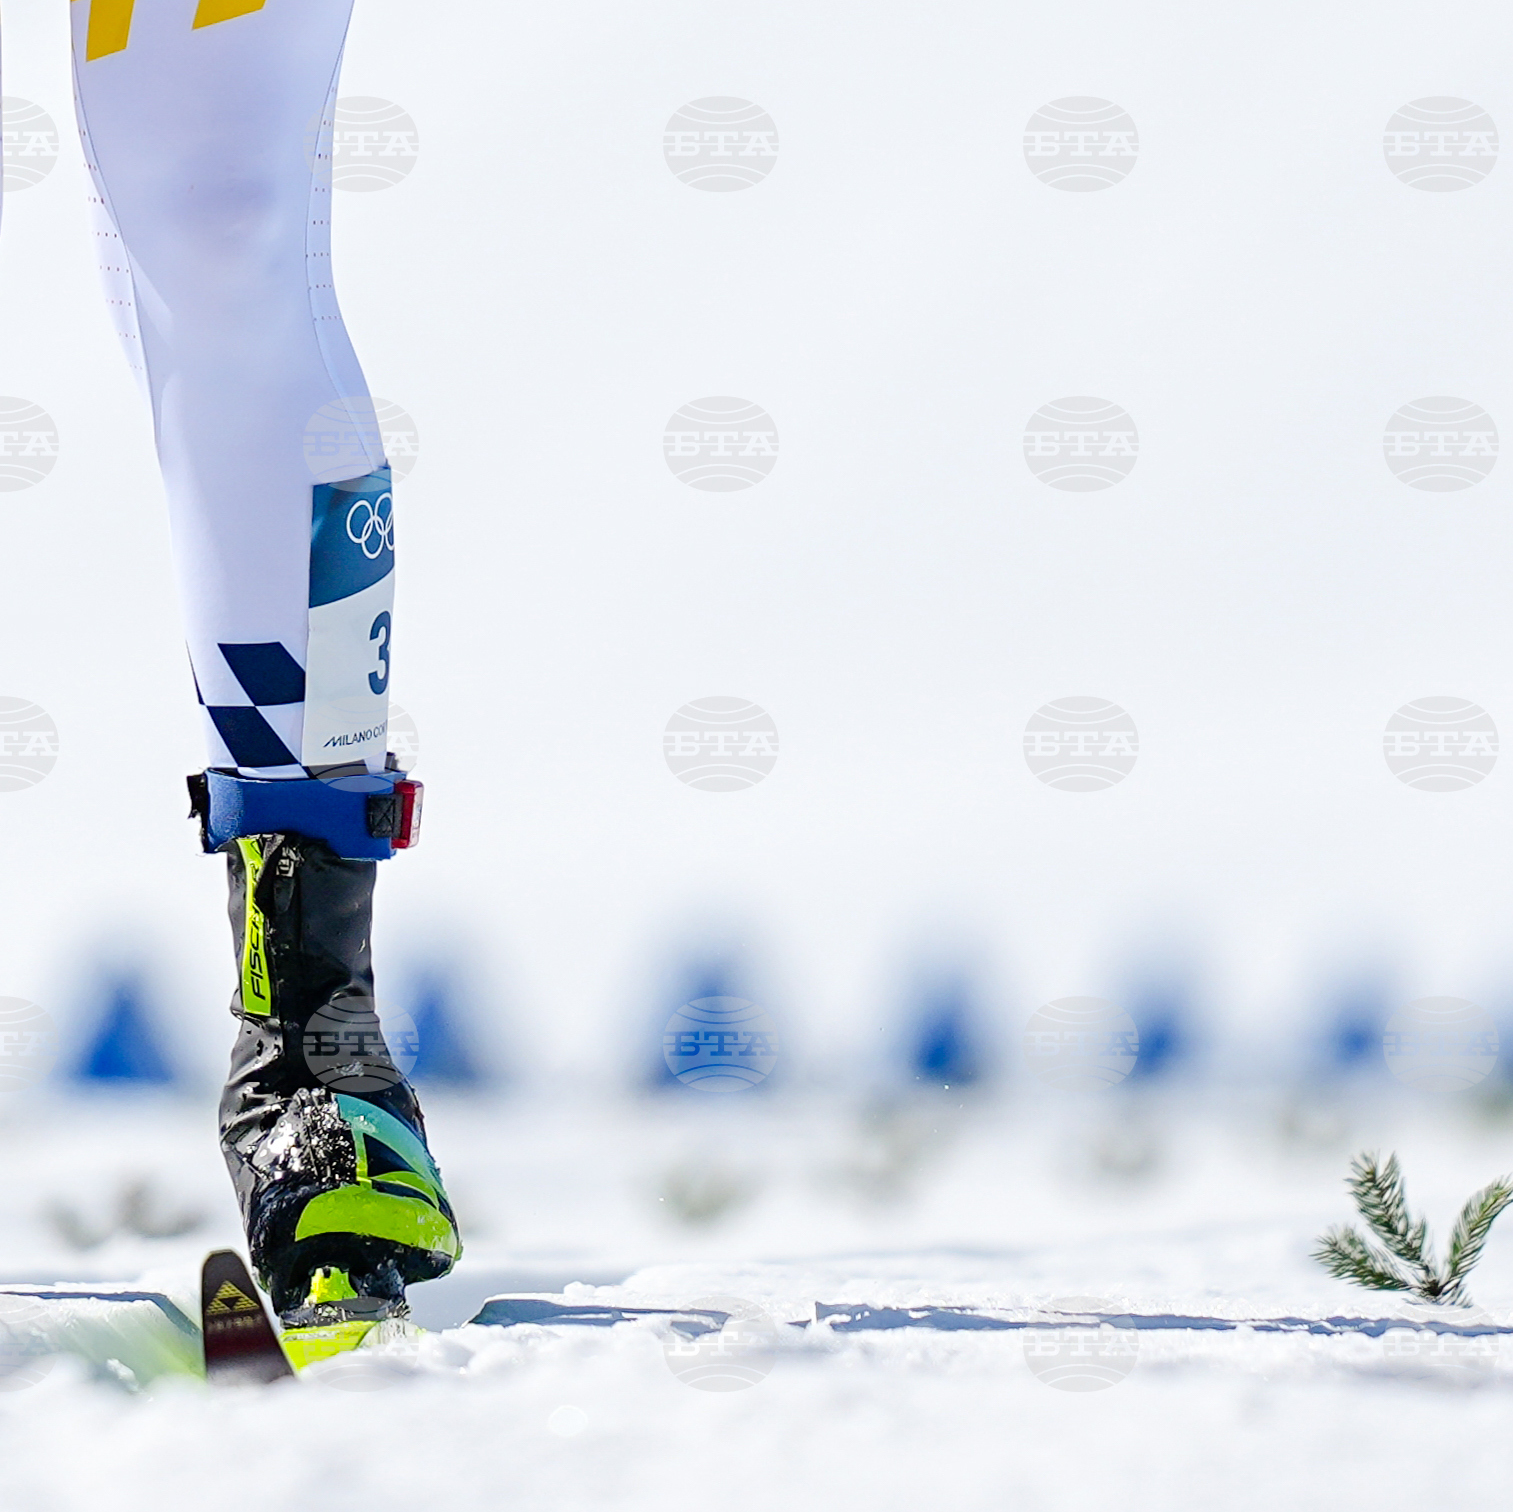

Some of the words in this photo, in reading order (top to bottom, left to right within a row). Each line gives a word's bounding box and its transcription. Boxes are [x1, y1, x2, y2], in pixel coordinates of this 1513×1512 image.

[367, 610, 392, 696] 3
[322, 728, 373, 748] MILANO
[249, 863, 266, 1000] FISCH
